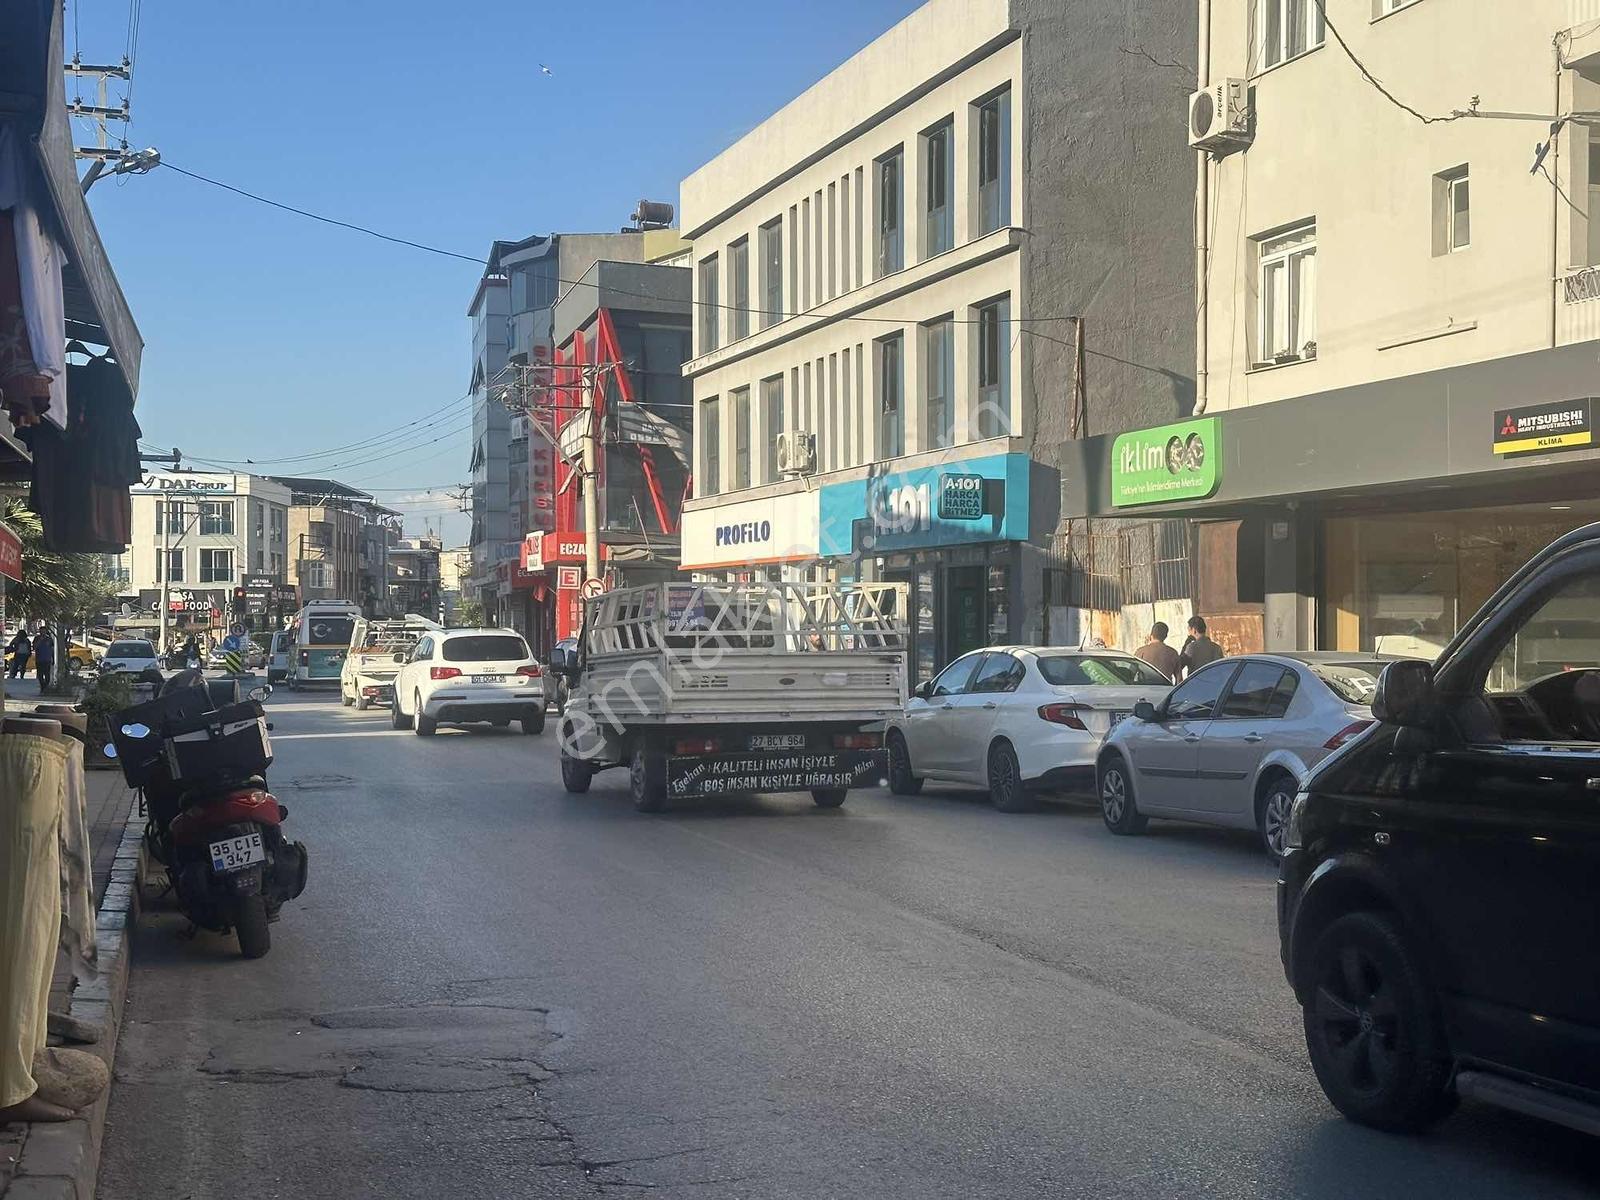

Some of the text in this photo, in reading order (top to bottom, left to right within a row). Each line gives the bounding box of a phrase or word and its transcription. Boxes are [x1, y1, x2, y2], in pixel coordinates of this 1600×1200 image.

[1517, 410, 1583, 428] MITSUBISHI
[945, 490, 980, 499] HARCA
[945, 499, 980, 508] HARCA
[560, 543, 587, 555] ECZA
[564, 572, 576, 585] E
[184, 601, 209, 610] FOOD
[752, 735, 804, 746] 27 BCY 964
[212, 843, 230, 856] 35
[226, 851, 251, 866] 347
